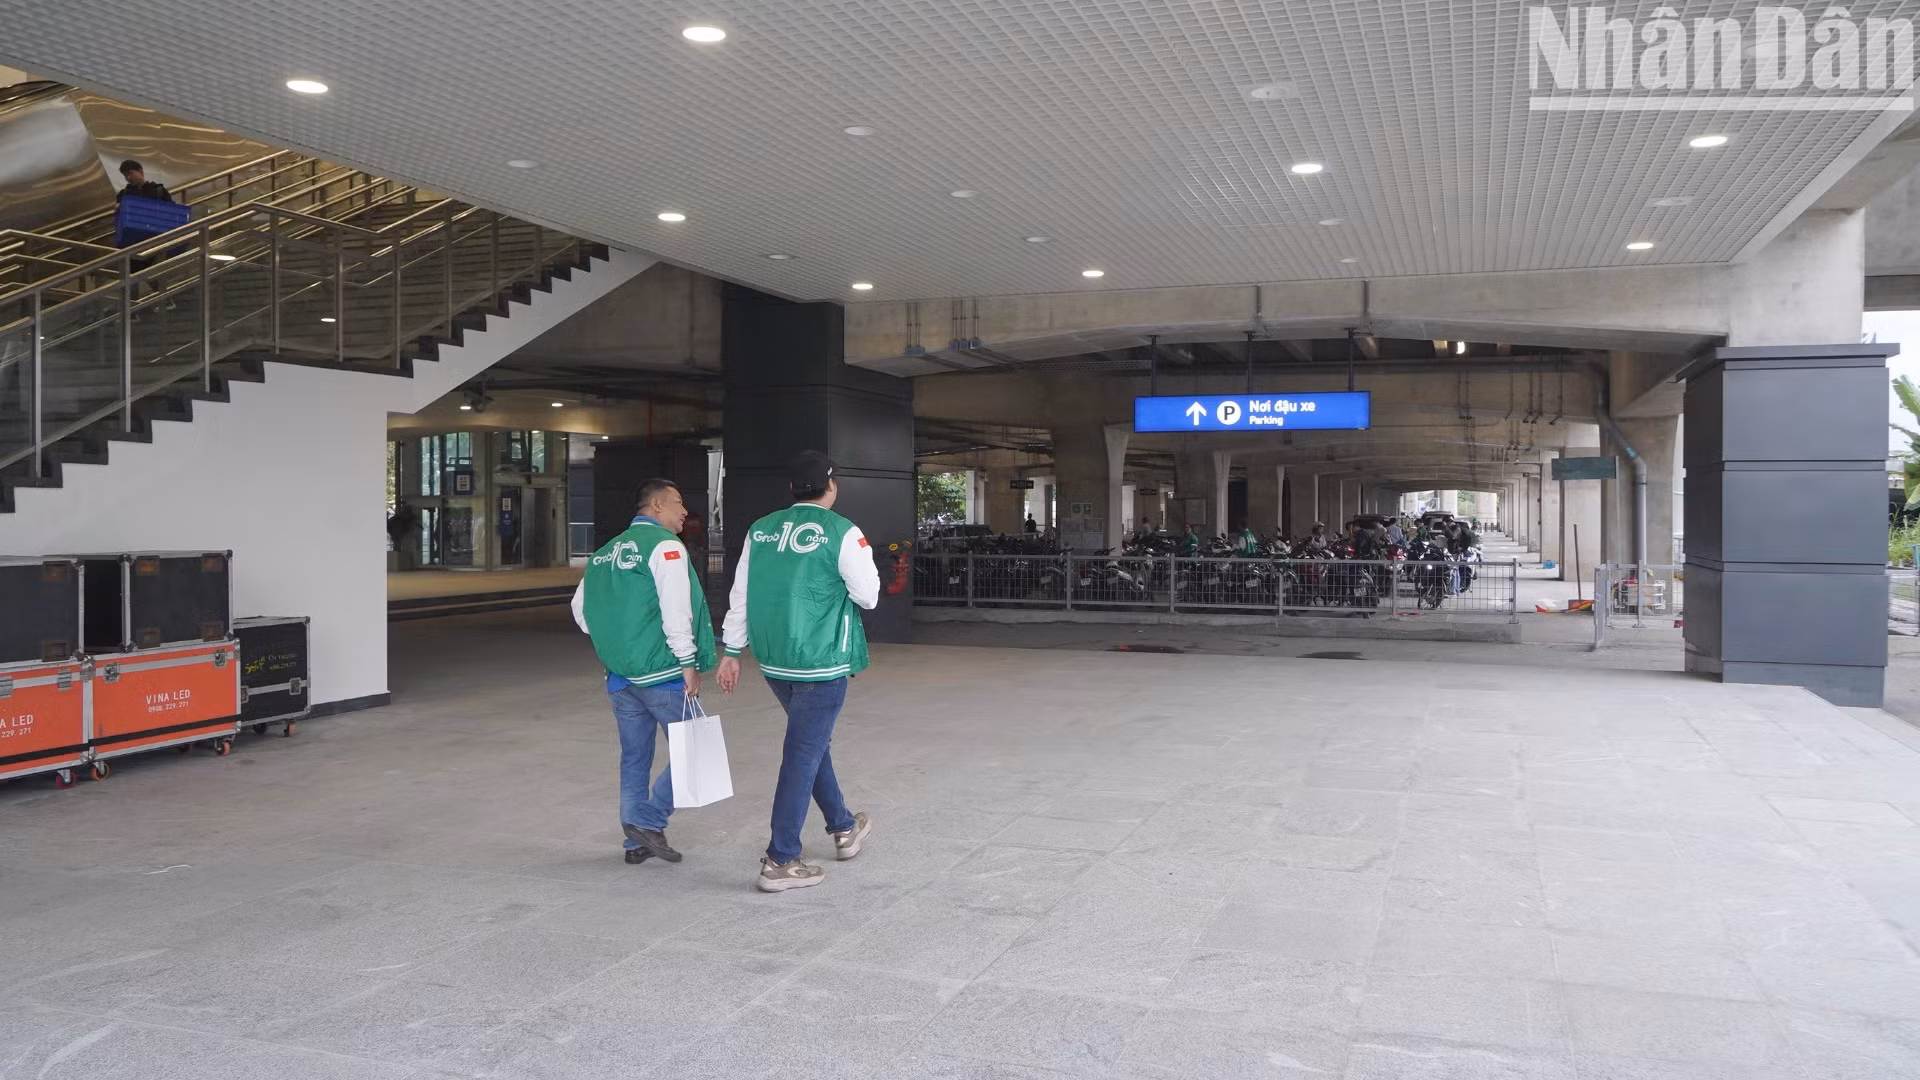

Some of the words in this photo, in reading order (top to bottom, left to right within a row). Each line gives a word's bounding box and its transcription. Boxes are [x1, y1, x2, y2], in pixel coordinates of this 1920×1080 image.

[1224, 406, 1235, 420] P
[1249, 400, 1271, 413] Nơi
[1274, 399, 1298, 415] đậu
[1300, 402, 1316, 412] xe
[1249, 415, 1284, 426] Parking
[753, 530, 780, 543] Grab
[777, 521, 825, 553] 10
[145, 692, 170, 704] VINA
[173, 689, 191, 701] LED
[12, 714, 34, 727] LED
